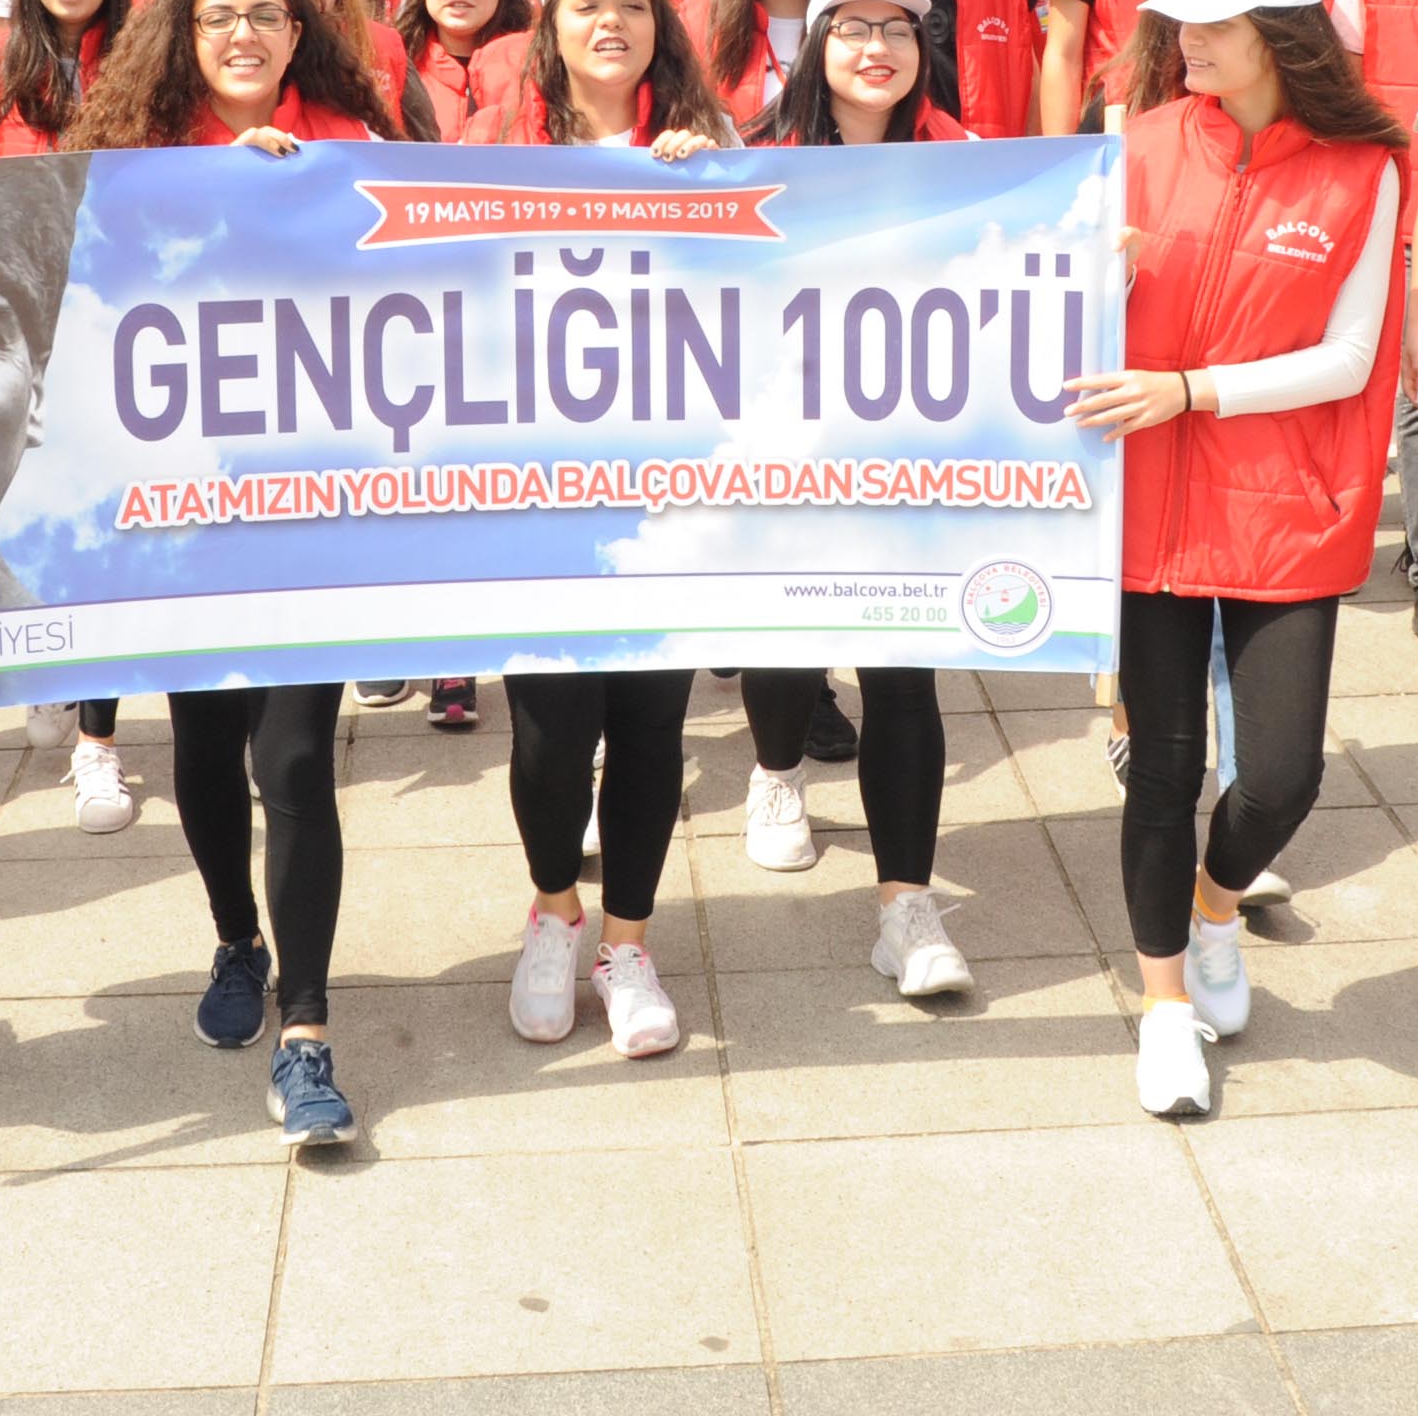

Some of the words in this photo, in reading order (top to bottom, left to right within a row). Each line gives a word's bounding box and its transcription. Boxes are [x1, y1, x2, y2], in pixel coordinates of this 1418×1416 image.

[403, 202, 430, 224] 19
[434, 200, 505, 223] MAYIS
[511, 201, 562, 220] 1919
[582, 202, 607, 219] 19
[612, 202, 682, 219] MAYIS
[687, 202, 739, 219] 2019
[1266, 221, 1335, 253] BALÇOVA
[1267, 242, 1328, 264] BELEDİYESİ
[113, 247, 741, 453] GENÇLİĞİN
[783, 252, 1084, 425] 100'Ü
[121, 475, 335, 525] ATA'MIZIN
[343, 468, 549, 511] YOLUNDA
[558, 464, 853, 507] BALÇOVA'DAN
[863, 463, 1085, 504] SAMSUN'A
[783, 581, 948, 598] www.balcova.bel.tr
[862, 606, 894, 622] 455
[900, 606, 920, 622] 20
[926, 607, 948, 622] 00
